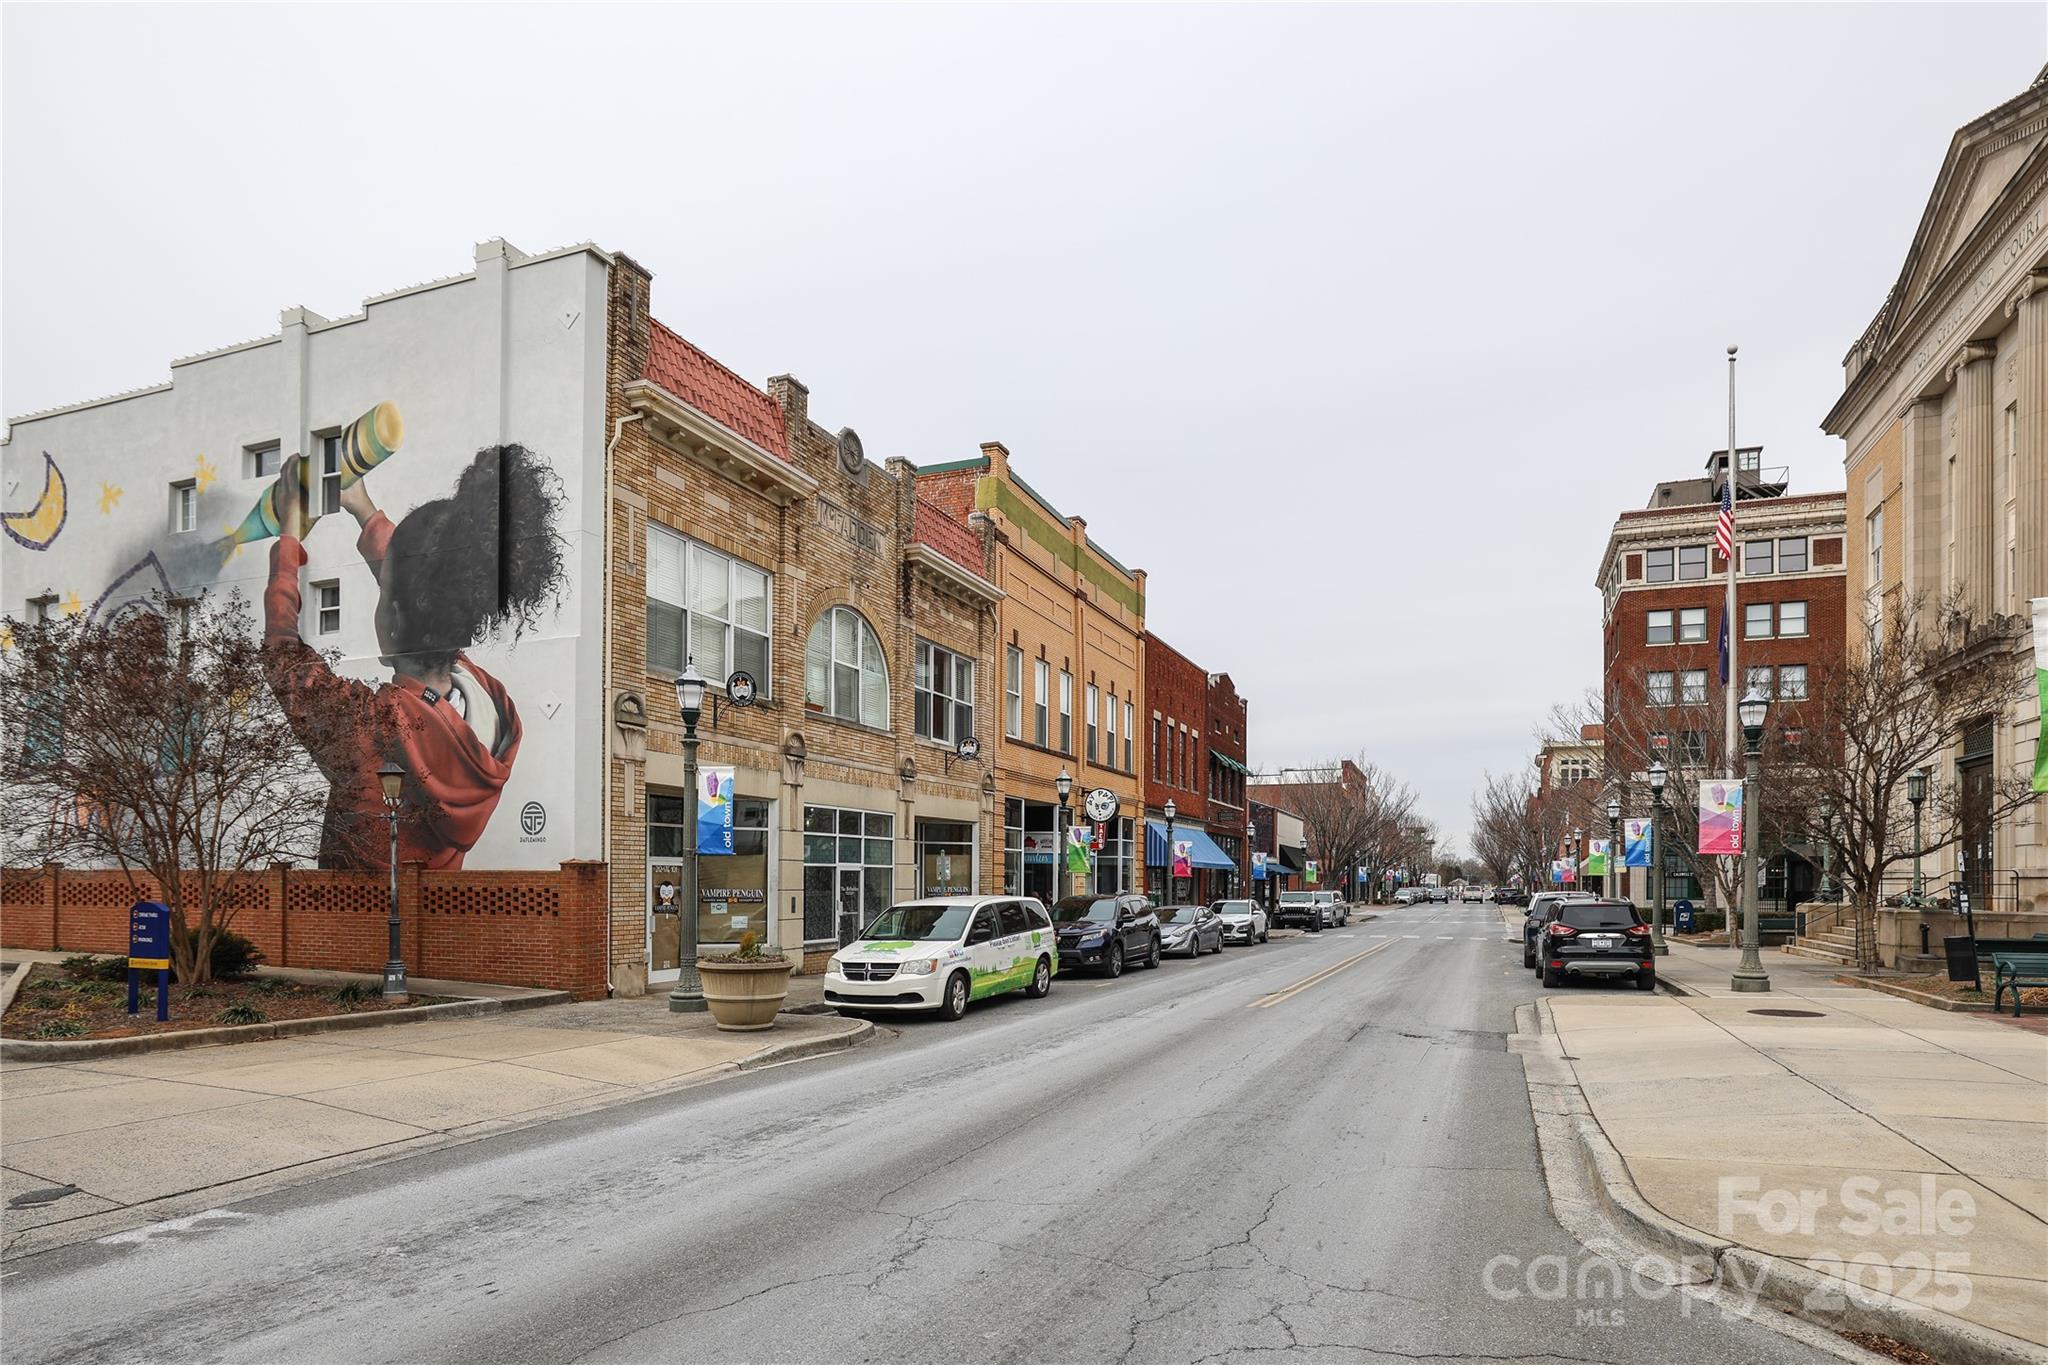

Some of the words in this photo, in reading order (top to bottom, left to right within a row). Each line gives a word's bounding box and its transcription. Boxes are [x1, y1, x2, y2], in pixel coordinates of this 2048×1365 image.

[2002, 209, 2042, 267] COURT
[723, 801, 732, 828] town
[1730, 809, 1739, 832] town
[722, 831, 732, 848] old
[1730, 834, 1739, 848] old
[701, 888, 731, 898] VAMPIRE
[732, 888, 764, 898] PENGUIN
